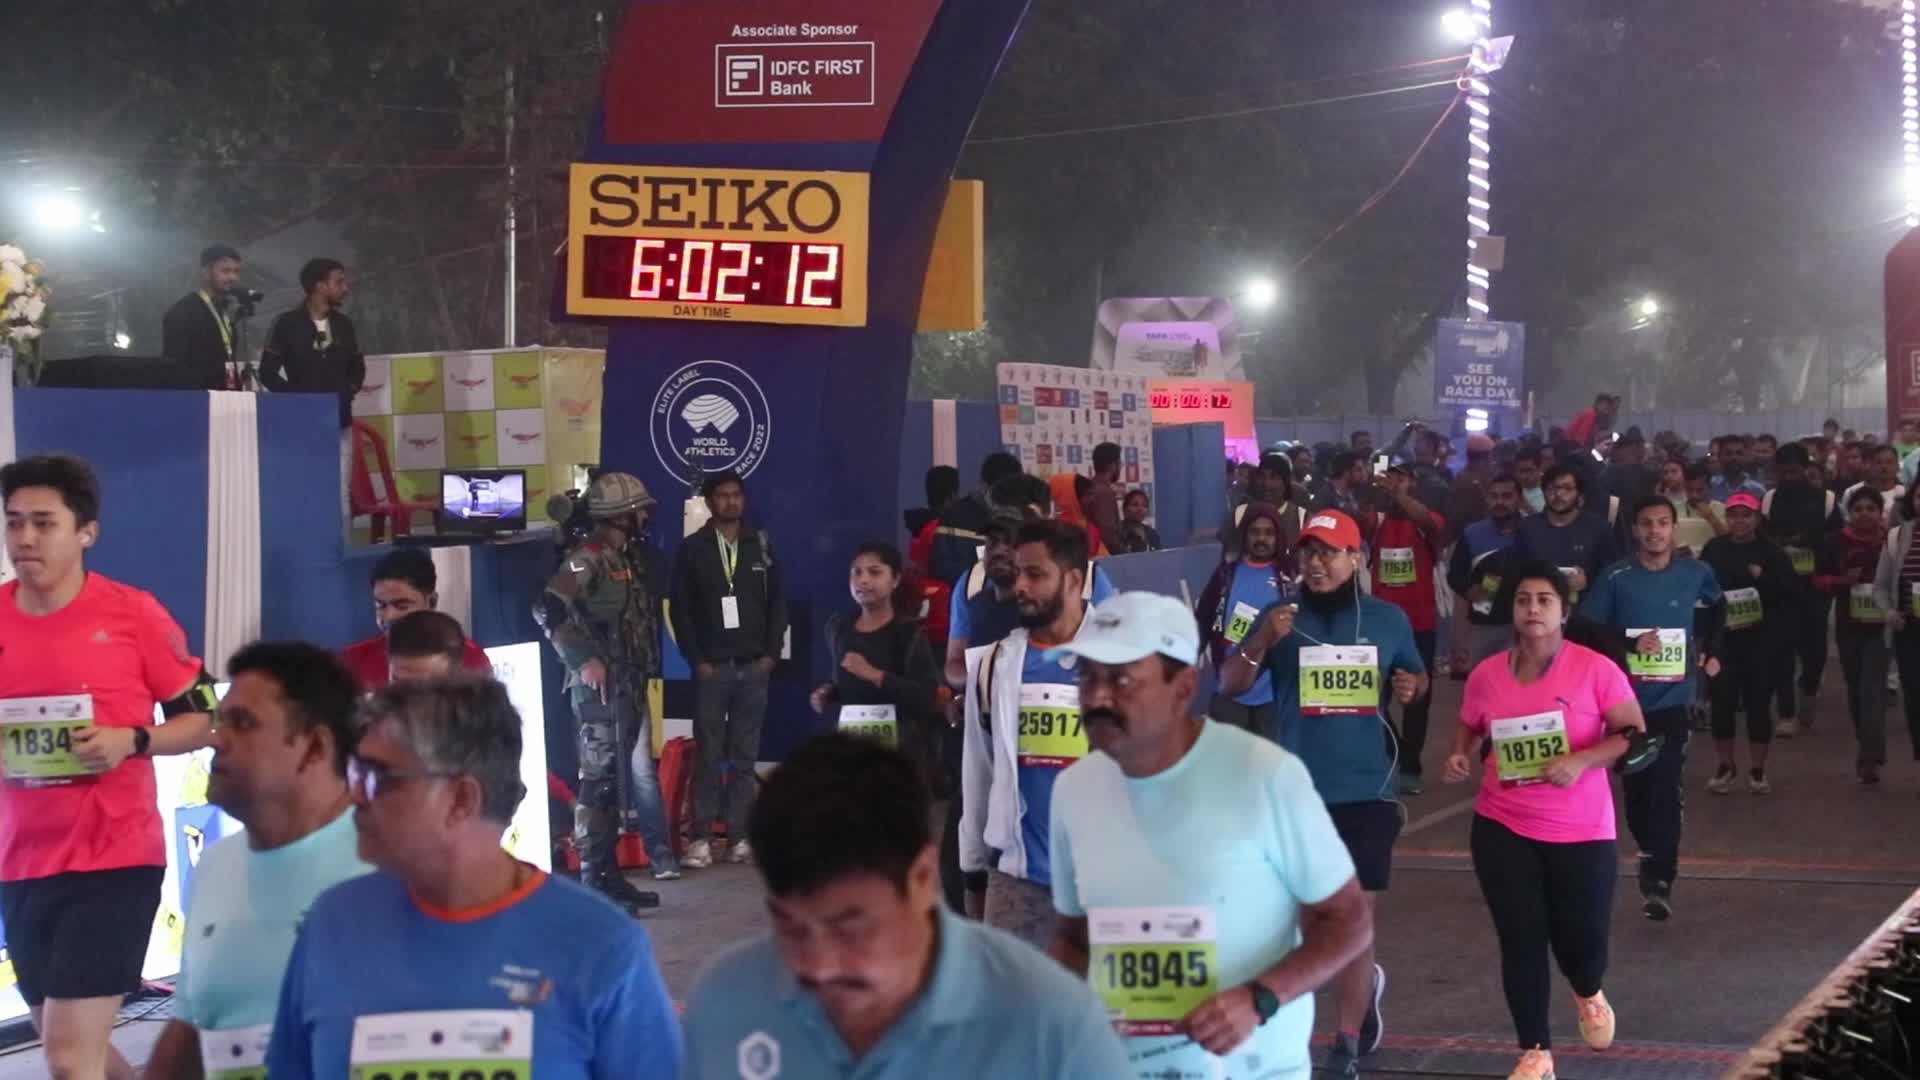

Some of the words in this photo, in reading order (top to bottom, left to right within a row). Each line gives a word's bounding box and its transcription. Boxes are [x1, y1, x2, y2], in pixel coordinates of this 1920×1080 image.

[731, 24, 797, 37] Associate
[801, 23, 858, 38] Sponsor
[770, 60, 810, 76] IDFC
[815, 59, 864, 75] FIRST
[770, 80, 812, 95] Bank
[589, 174, 841, 234] SEIKO
[673, 305, 697, 316] DAY
[702, 306, 731, 318] TIME
[1467, 364, 1493, 374] SEE
[1453, 375, 1482, 385] YOU
[1486, 375, 1508, 386] ON
[657, 387, 675, 414] ELITE
[673, 369, 700, 389] LABEL
[1445, 386, 1482, 397] RACE
[1486, 386, 1516, 399] DAY
[693, 438, 728, 447] WORLD
[735, 451, 757, 474] RACE
[753, 424, 765, 451] 2022
[685, 447, 736, 456] ATHLETICS
[1310, 670, 1373, 690] 18824
[1018, 711, 1081, 737] 25917
[1502, 736, 1564, 763] 18752
[1104, 951, 1208, 989] 18945
